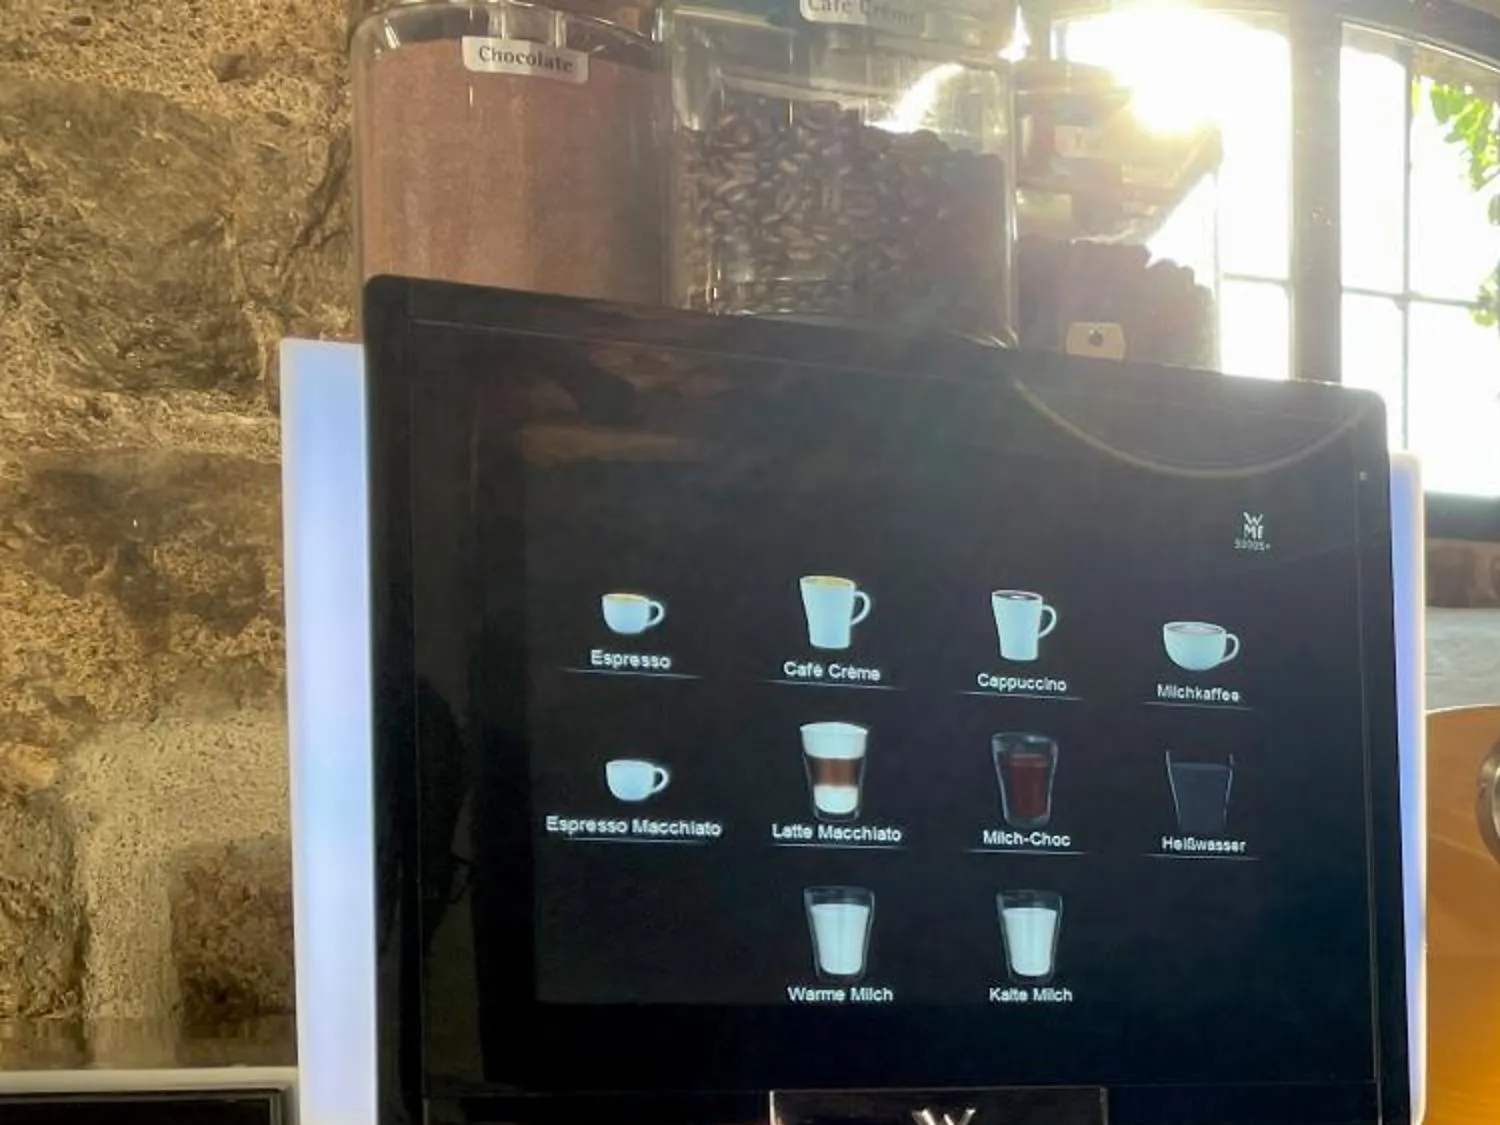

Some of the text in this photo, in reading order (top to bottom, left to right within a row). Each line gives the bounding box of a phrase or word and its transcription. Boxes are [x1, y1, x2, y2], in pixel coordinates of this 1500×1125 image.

[478, 45, 574, 73] Chocolate
[590, 649, 672, 670] Espresso
[976, 672, 1068, 693] Cappuccino
[1157, 683, 1240, 703] Milchkaffee
[545, 815, 722, 837] Espresso Macchiato
[772, 823, 902, 842] Latte Macchiato
[982, 829, 1072, 848] Milch-Choc
[1161, 835, 1248, 854] Heißwasser
[787, 986, 894, 1002] Warme Milch
[989, 987, 1074, 1003] Kalte Milch
